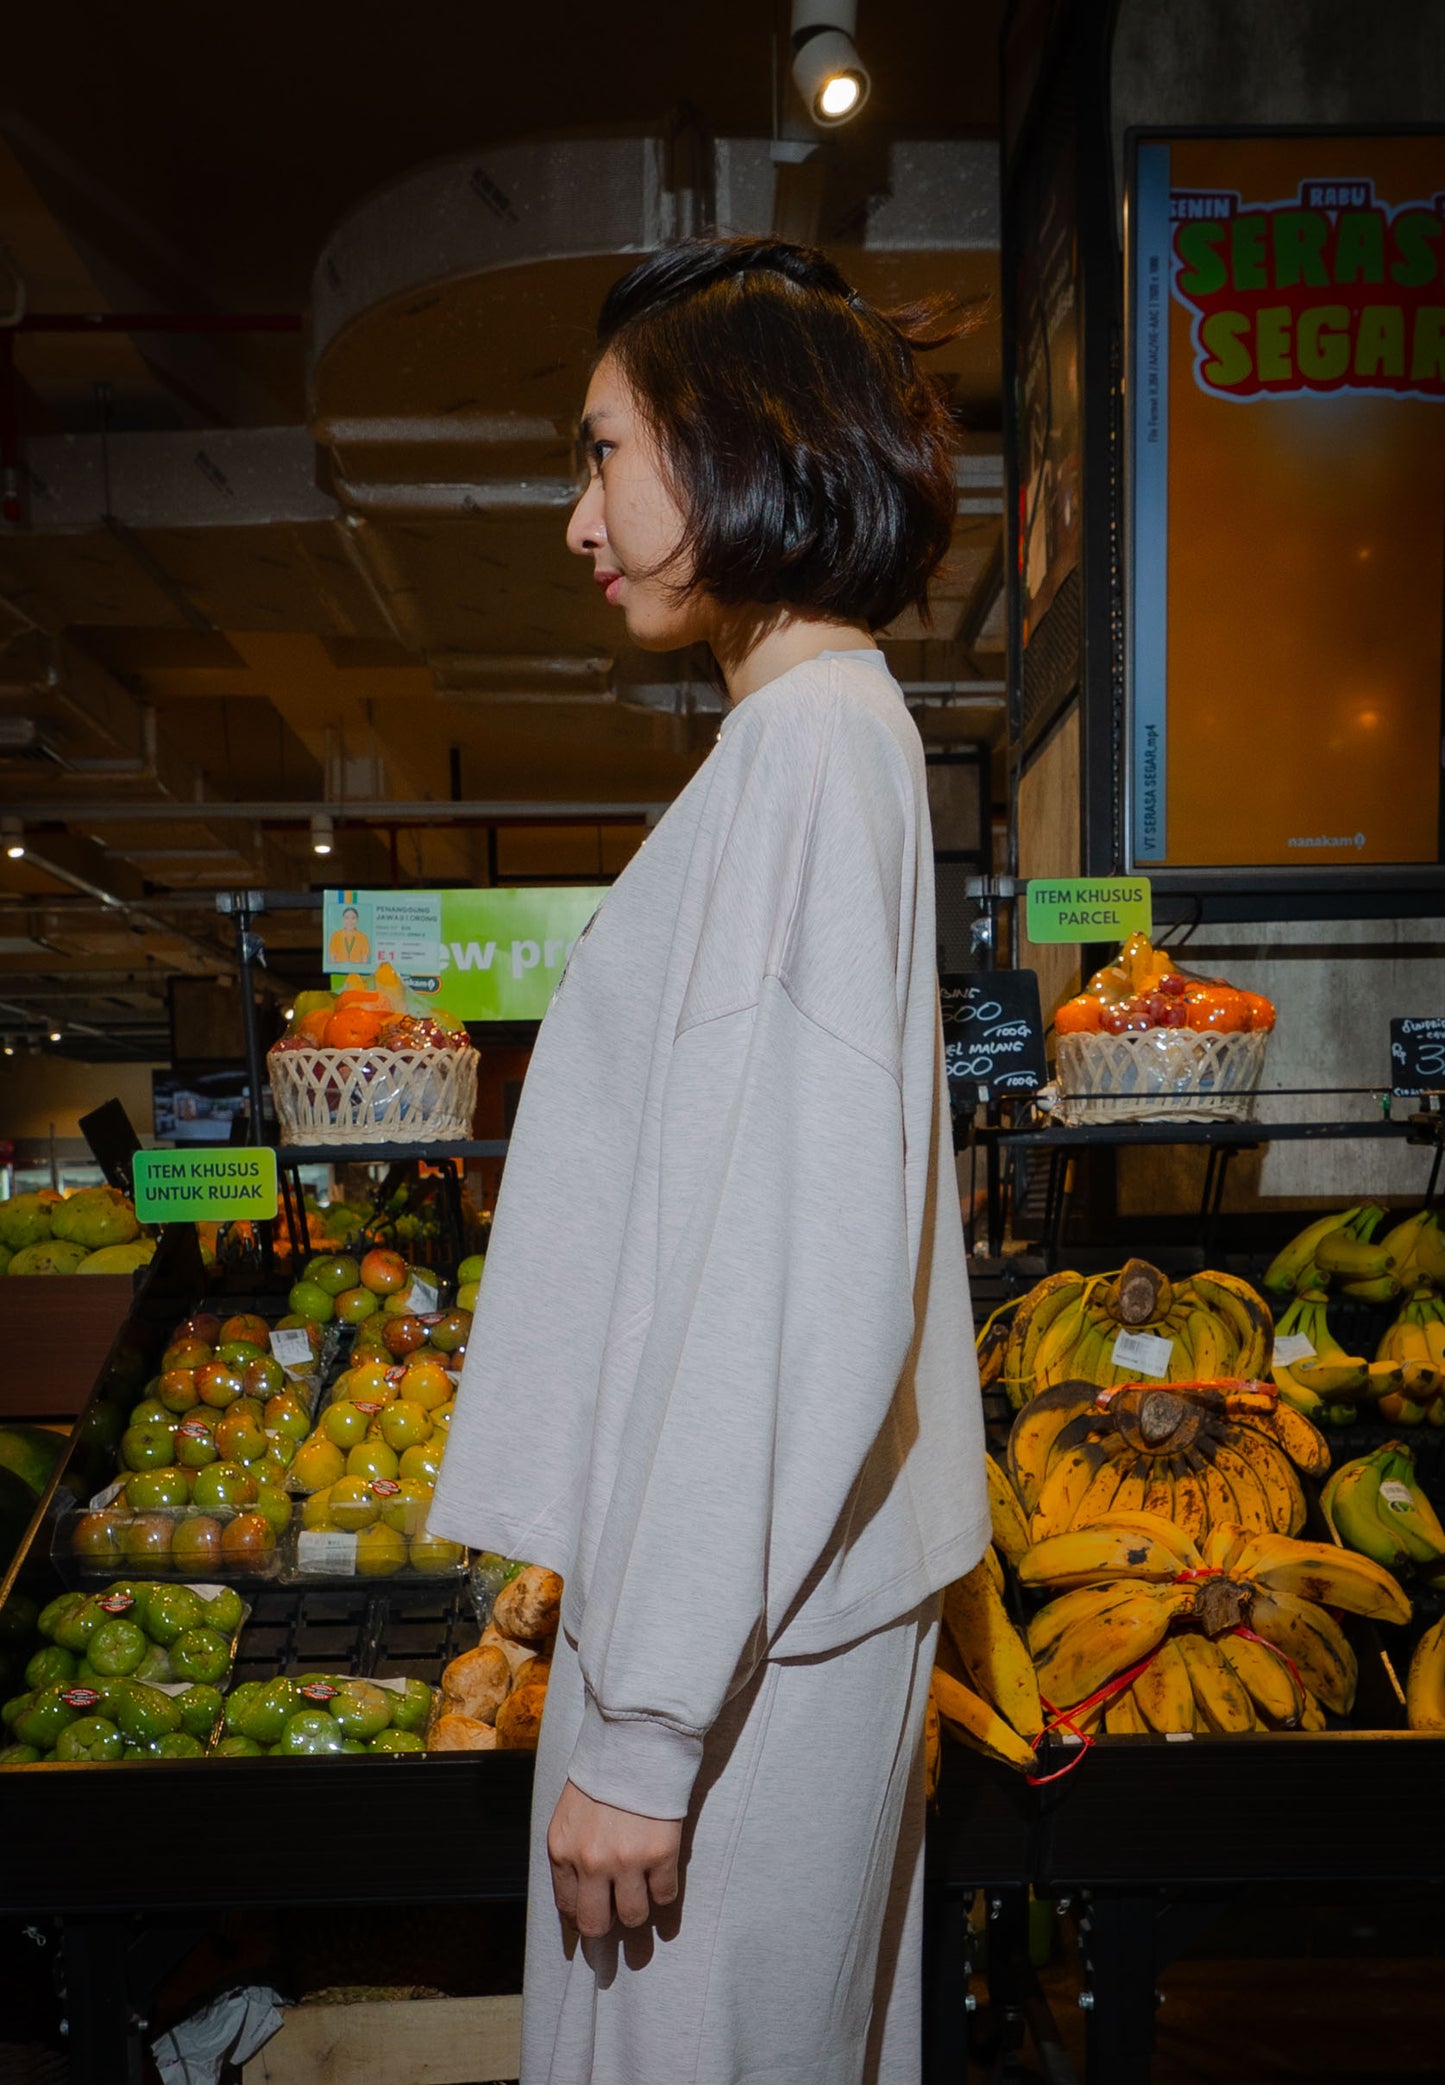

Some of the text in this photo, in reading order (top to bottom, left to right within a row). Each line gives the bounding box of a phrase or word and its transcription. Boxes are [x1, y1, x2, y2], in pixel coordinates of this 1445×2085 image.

[1309, 187, 1366, 208] RABU
[1178, 211, 1445, 297] SERAS
[1144, 789, 1156, 835] SERASA
[1144, 836, 1156, 851] VT
[1035, 888, 1143, 904] ITEM KHUSUS
[1058, 911, 1120, 925] PARCEL
[511, 940, 578, 980] pr
[147, 1162, 260, 1179] ITEM KHUSUS
[145, 1184, 263, 1201] UNTUK RUJAK
